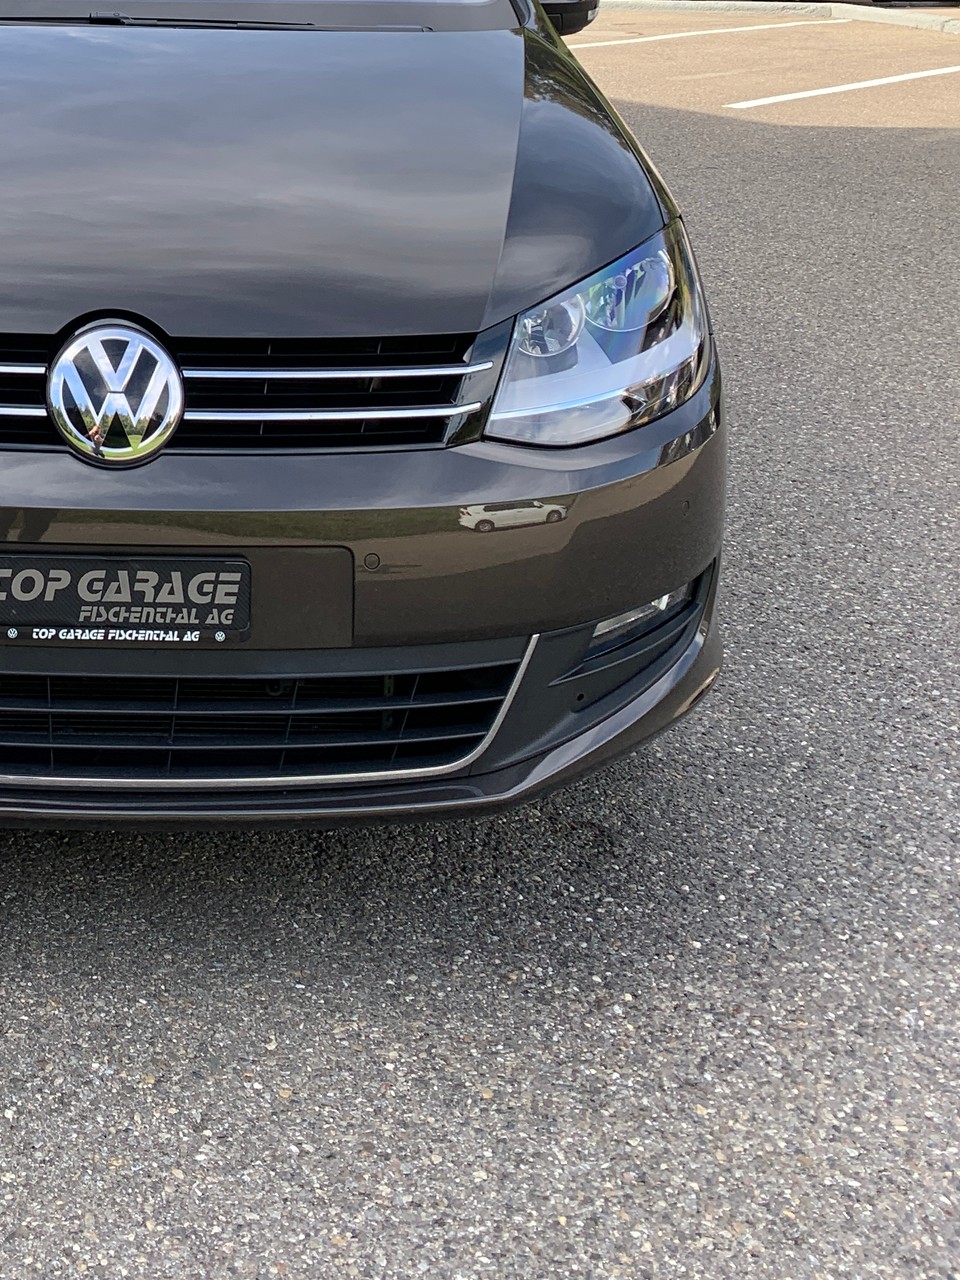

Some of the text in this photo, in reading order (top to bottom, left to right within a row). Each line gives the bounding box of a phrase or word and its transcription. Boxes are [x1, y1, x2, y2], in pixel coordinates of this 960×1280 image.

[50, 328, 182, 459] VW
[77, 570, 242, 605] GARAGE
[78, 606, 235, 625] FISCHENTHAL AG
[32, 628, 57, 639] TOP
[58, 628, 106, 640] GARAGE
[107, 629, 180, 641] FISCHENTHAL
[182, 630, 200, 642] AG
